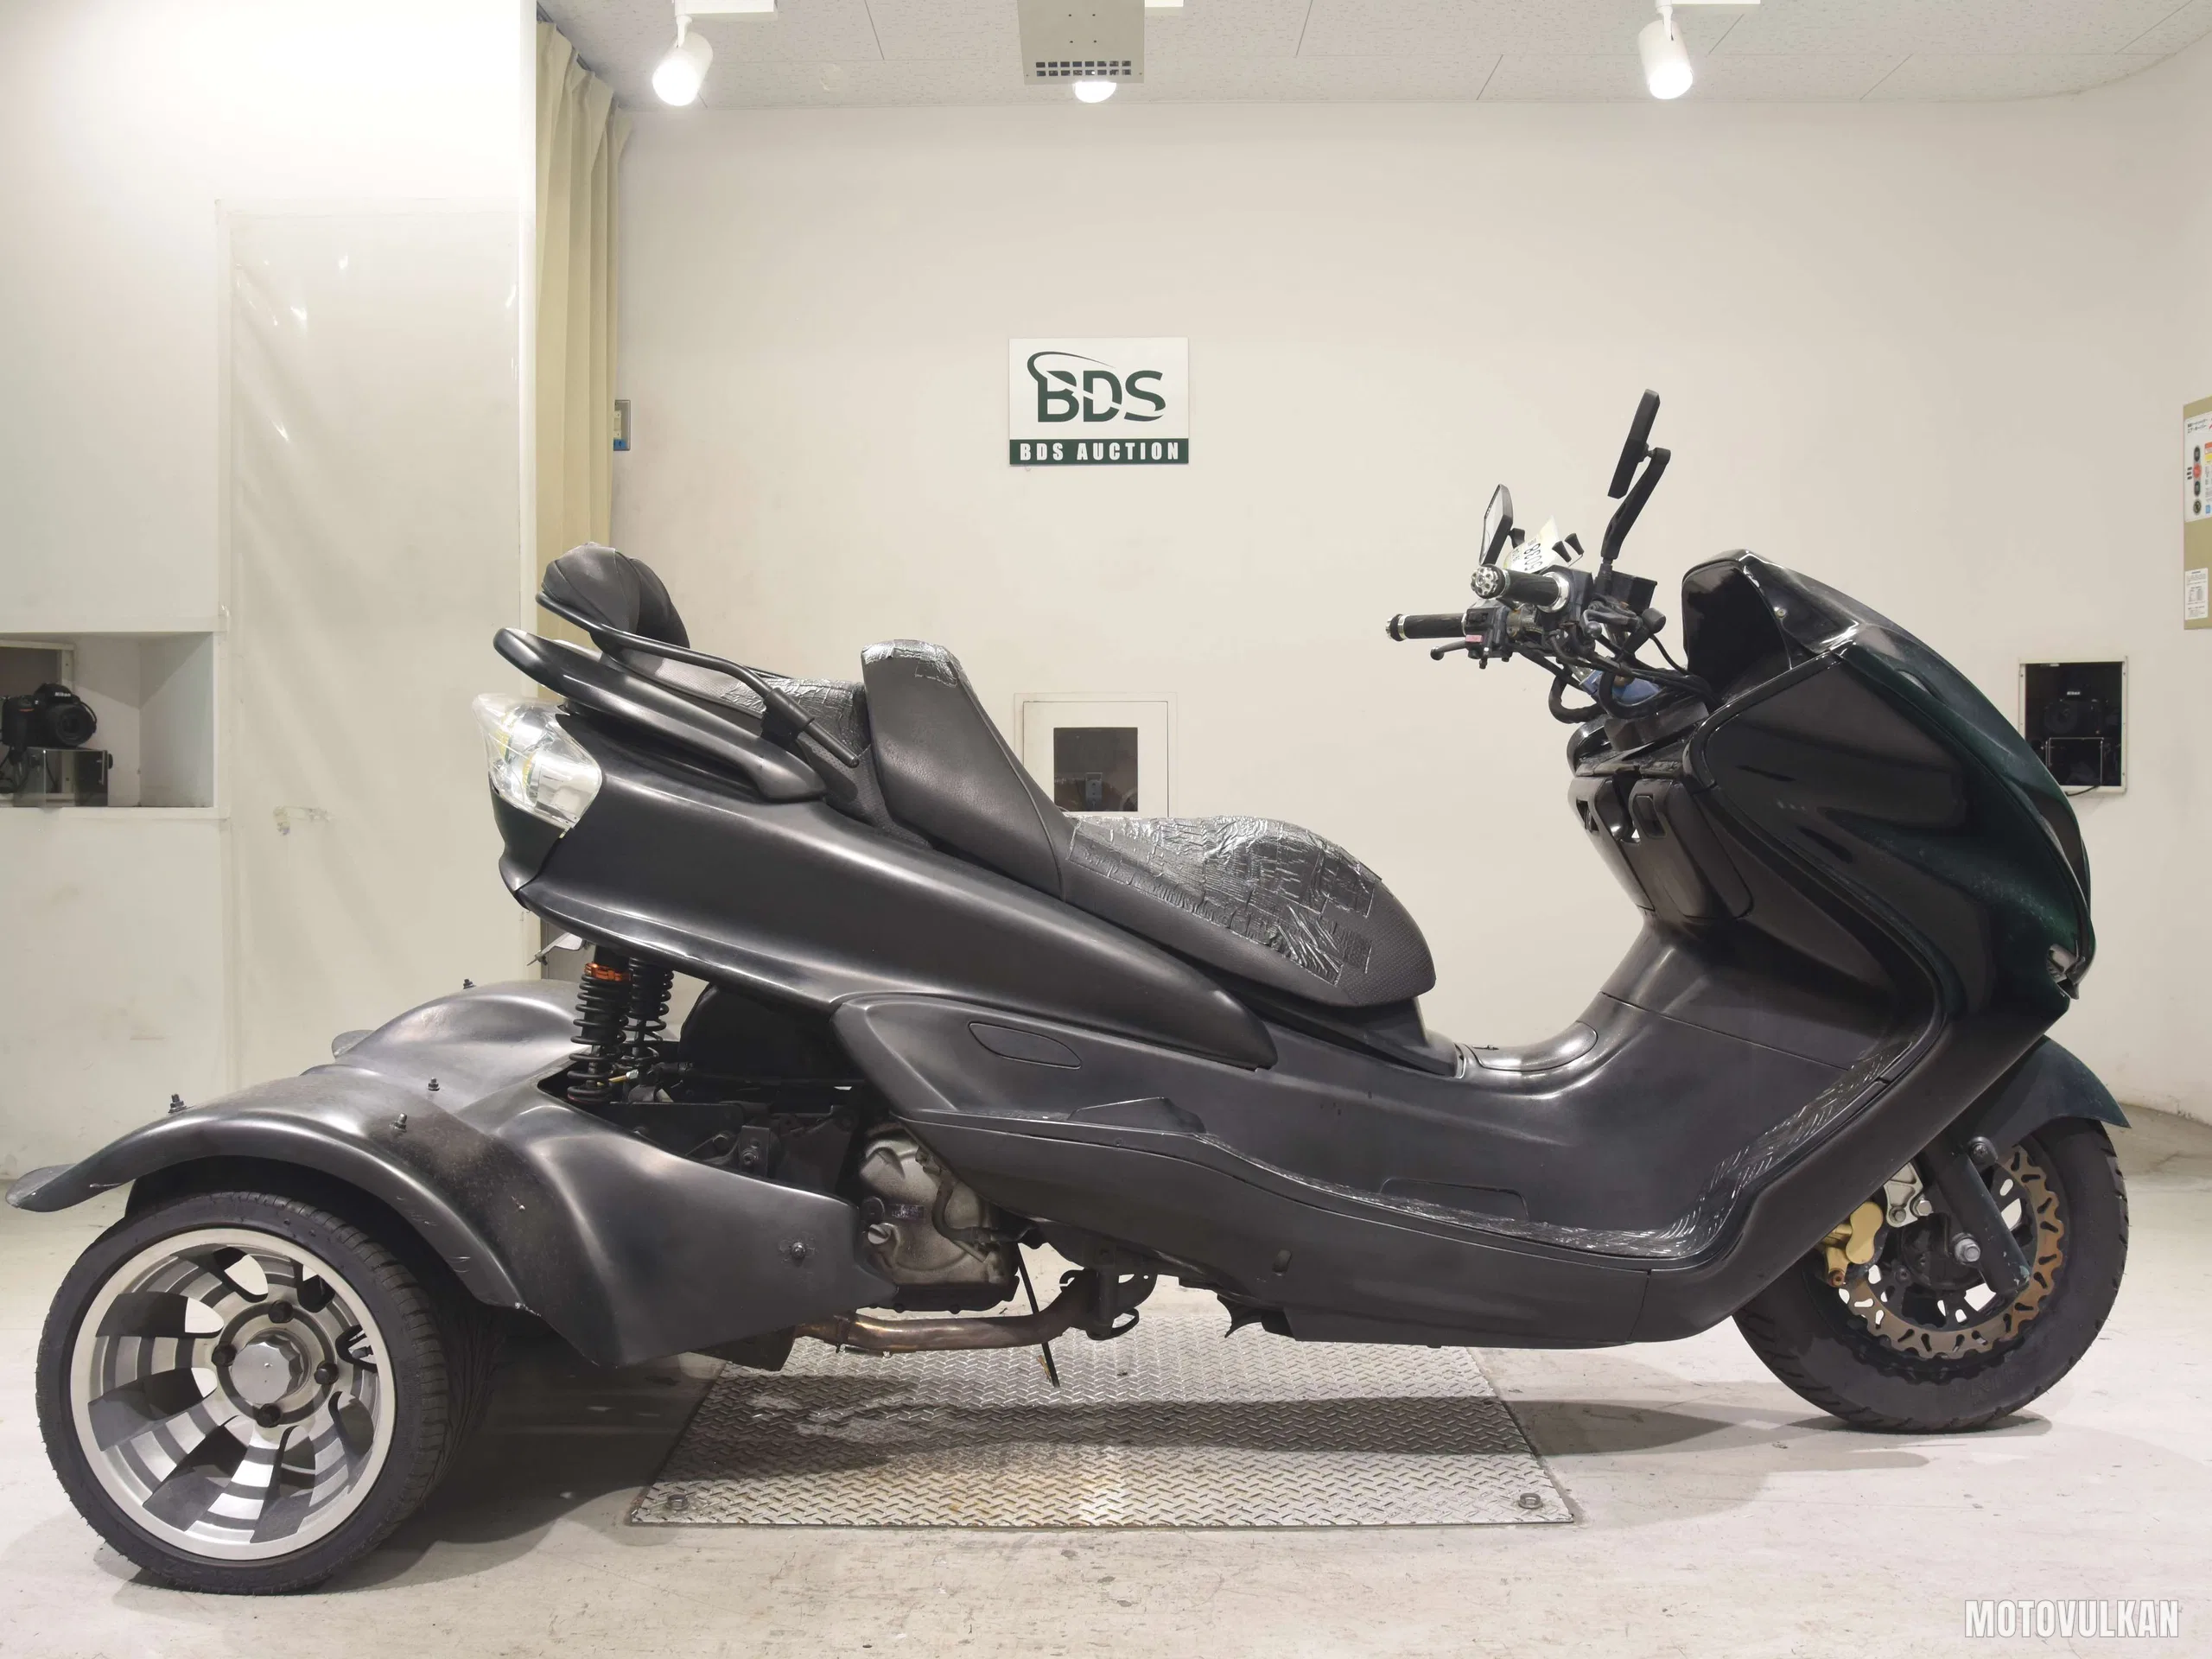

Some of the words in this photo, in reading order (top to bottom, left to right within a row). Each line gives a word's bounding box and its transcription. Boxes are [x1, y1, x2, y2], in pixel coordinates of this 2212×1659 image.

[1027, 351, 1166, 423] BDS
[1020, 442, 1064, 461] BDS
[1077, 442, 1179, 461] AUCTION
